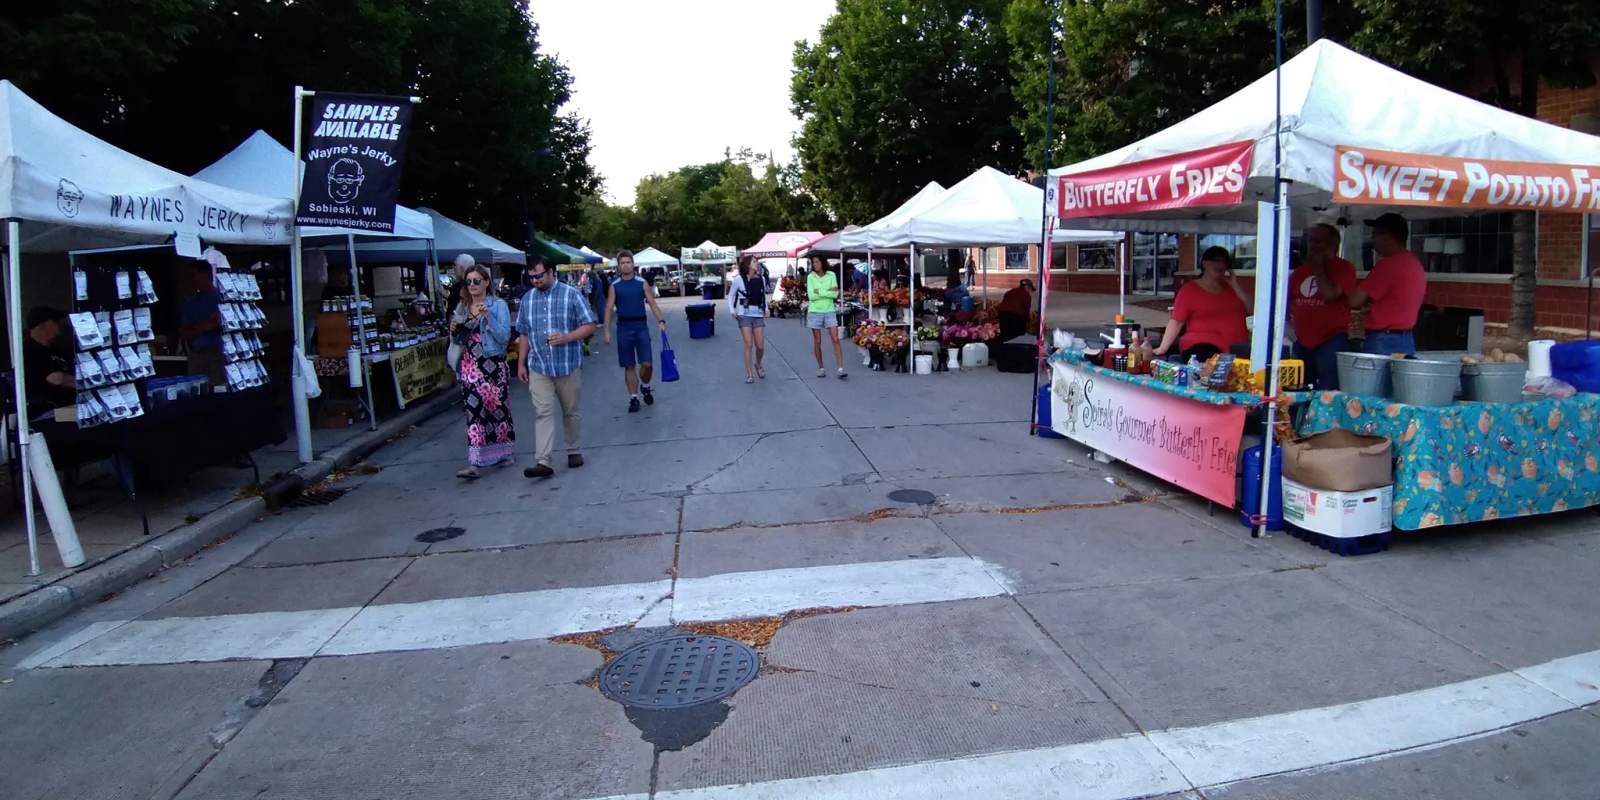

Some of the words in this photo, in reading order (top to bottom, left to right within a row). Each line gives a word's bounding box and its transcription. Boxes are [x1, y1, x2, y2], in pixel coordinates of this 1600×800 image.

[322, 103, 400, 121] SAMPLES
[313, 121, 402, 141] AVAILABLE
[308, 144, 358, 161] Wayne's
[361, 145, 397, 167] Jerky
[1063, 174, 1162, 211] BUTTERFLY
[1169, 162, 1243, 199] FRIES
[1337, 151, 1459, 201] SWEET
[1461, 162, 1570, 208] POTATO
[109, 195, 184, 223] WAYNES
[197, 205, 250, 233] JERKY
[308, 203, 359, 215] Sobieski,
[362, 206, 377, 217] WI
[296, 216, 392, 230] www.waynesjerky.com
[1115, 405, 1157, 446] Gourmet
[1159, 416, 1208, 471] Butterfly
